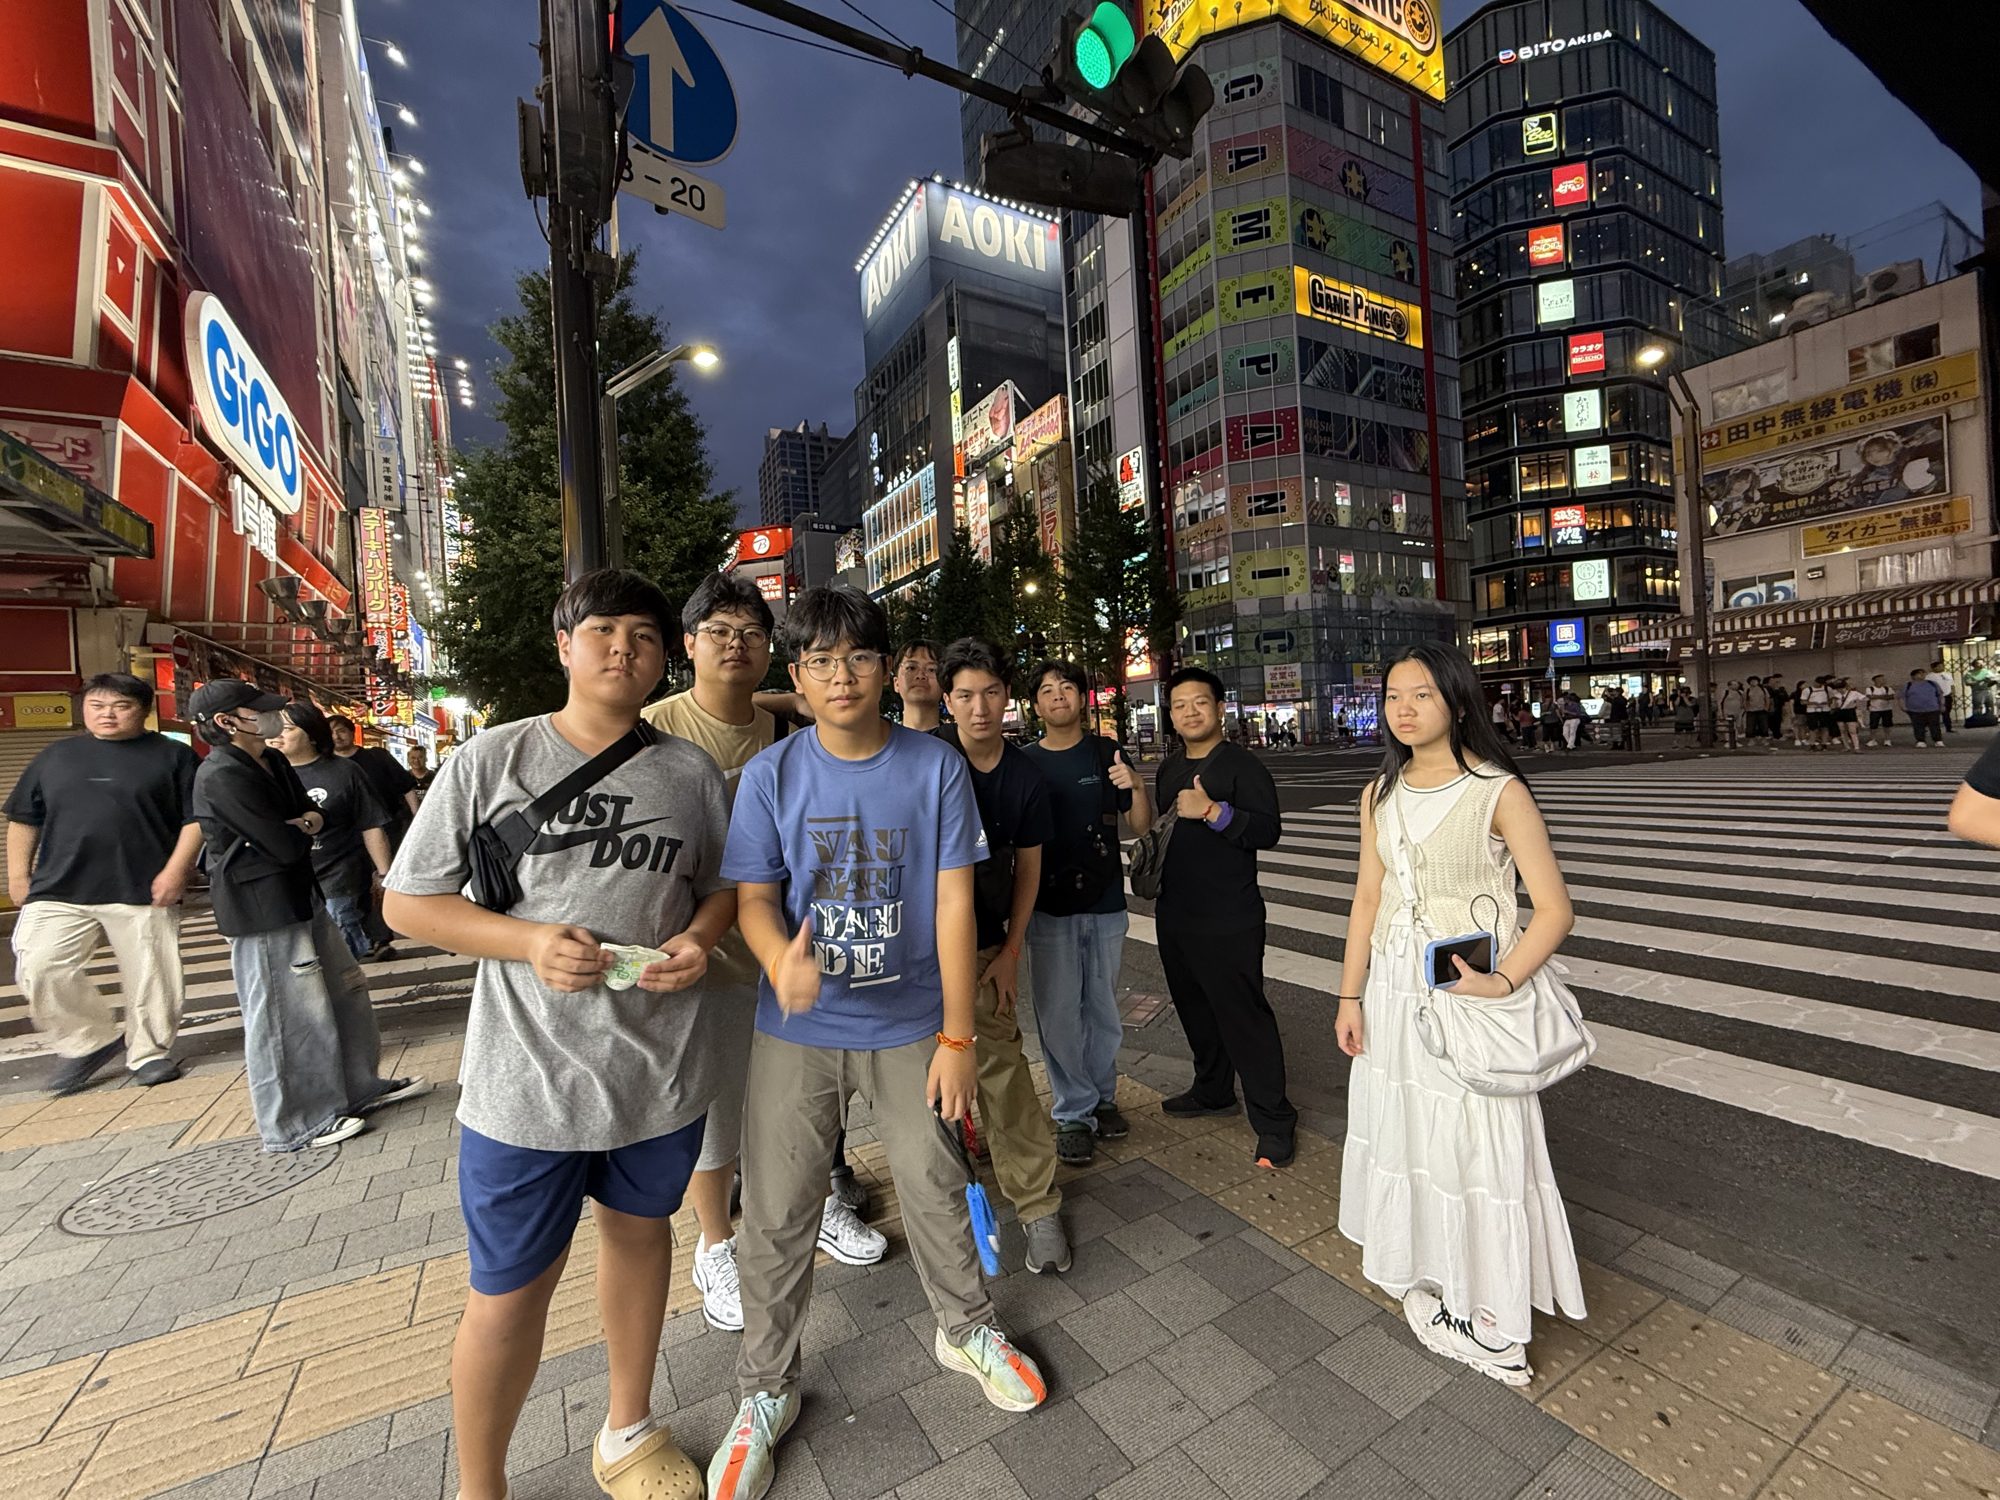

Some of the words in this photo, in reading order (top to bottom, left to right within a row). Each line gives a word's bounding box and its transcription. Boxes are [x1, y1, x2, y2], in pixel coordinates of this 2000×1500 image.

[939, 196, 1047, 272] AOKI
[866, 207, 918, 319] AOKI
[1309, 278, 1350, 318] GAME
[1352, 290, 1392, 328] PANIC
[1571, 343, 1604, 355] カラオケ
[206, 319, 297, 496] GiGO
[1726, 377, 1904, 444] 田中無線電機
[1833, 418, 1853, 429] TEL
[1858, 389, 1960, 424] 03-3253-4001
[227, 464, 277, 563] 1号館
[1825, 511, 1943, 543] タイガー無線
[1179, 525, 1223, 546] クレーンゲーム
[366, 612, 390, 622] 2F
[1835, 619, 1959, 644] タイガー無線
[1679, 636, 1797, 658] ミワデンキ
[548, 792, 634, 832] UST
[589, 833, 652, 870] DO
[647, 835, 684, 874] IT
